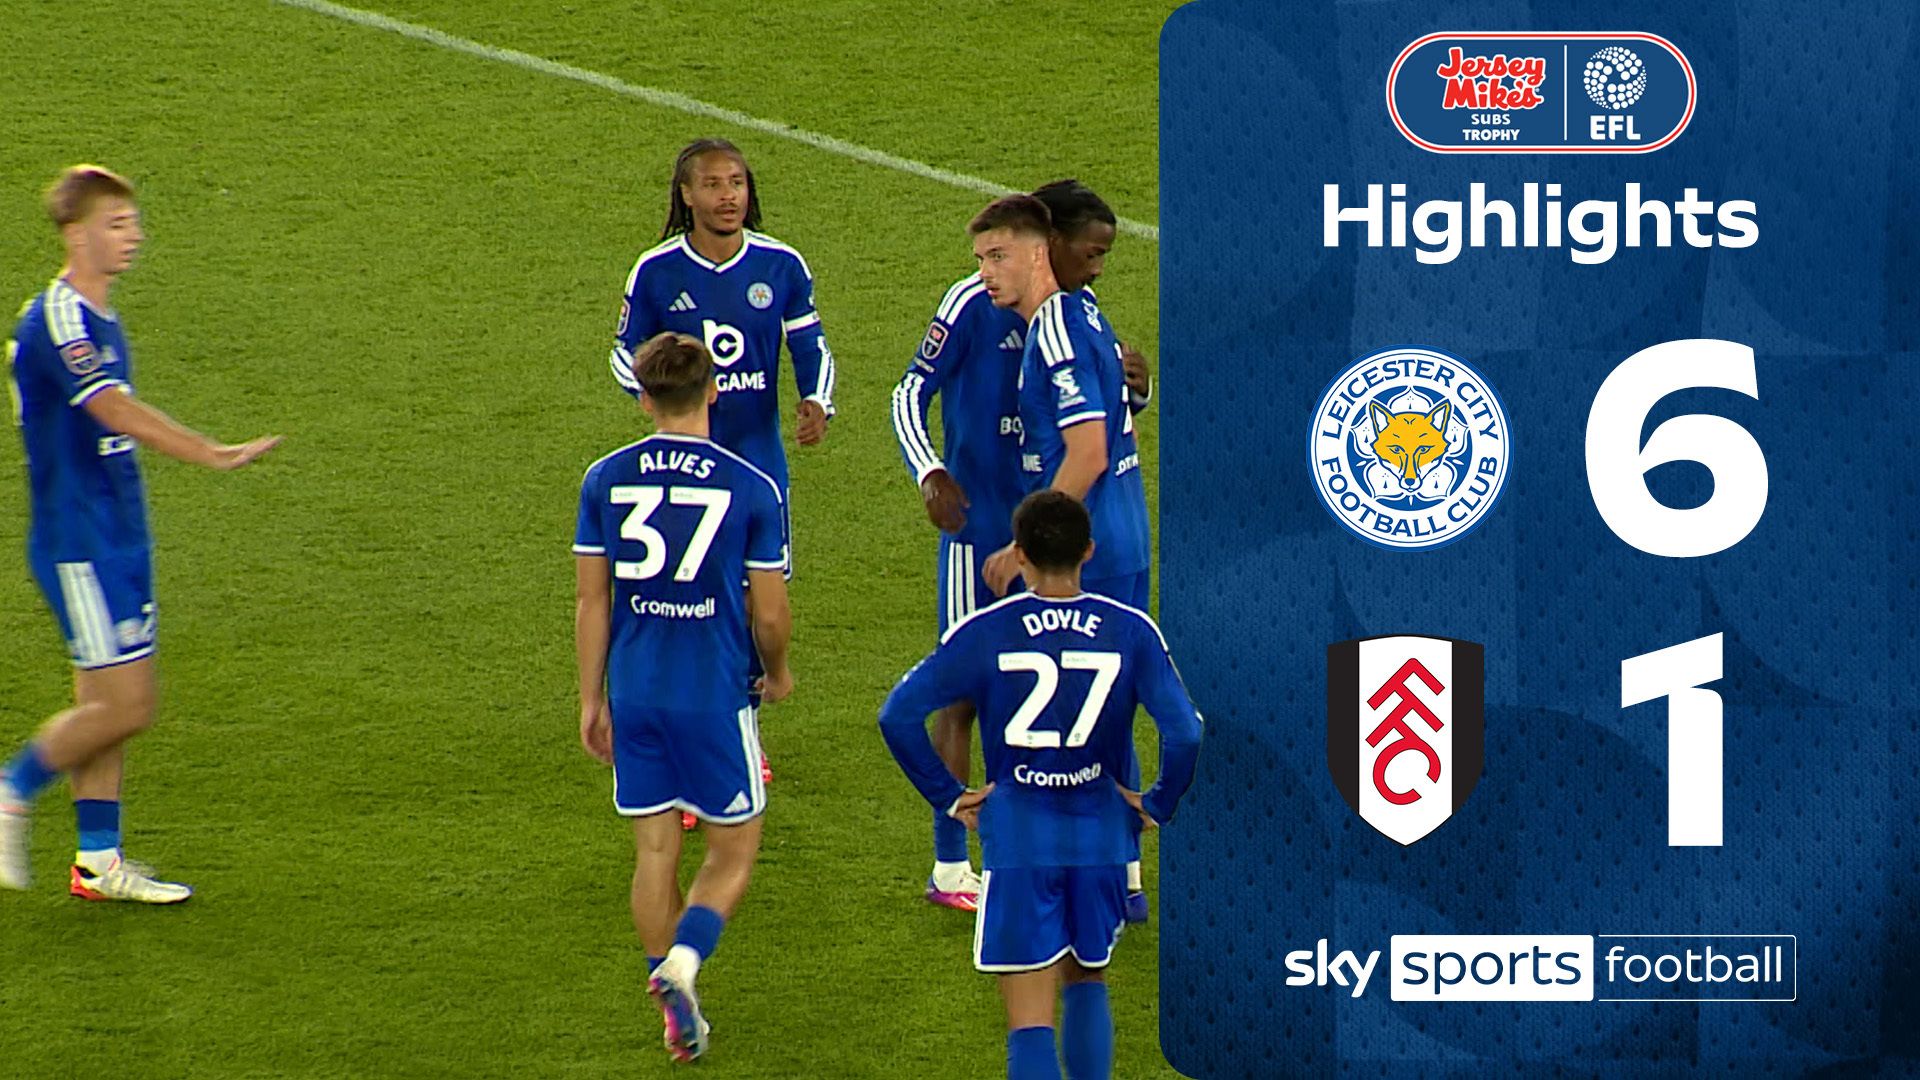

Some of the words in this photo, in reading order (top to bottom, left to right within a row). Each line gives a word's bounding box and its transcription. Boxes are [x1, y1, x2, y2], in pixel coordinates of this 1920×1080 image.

[715, 370, 767, 392] GAME
[639, 450, 717, 479] ALVES
[610, 486, 732, 582] 37
[630, 595, 716, 618] Cromwell
[1022, 608, 1102, 638] DOYLE
[998, 651, 1122, 748] 27
